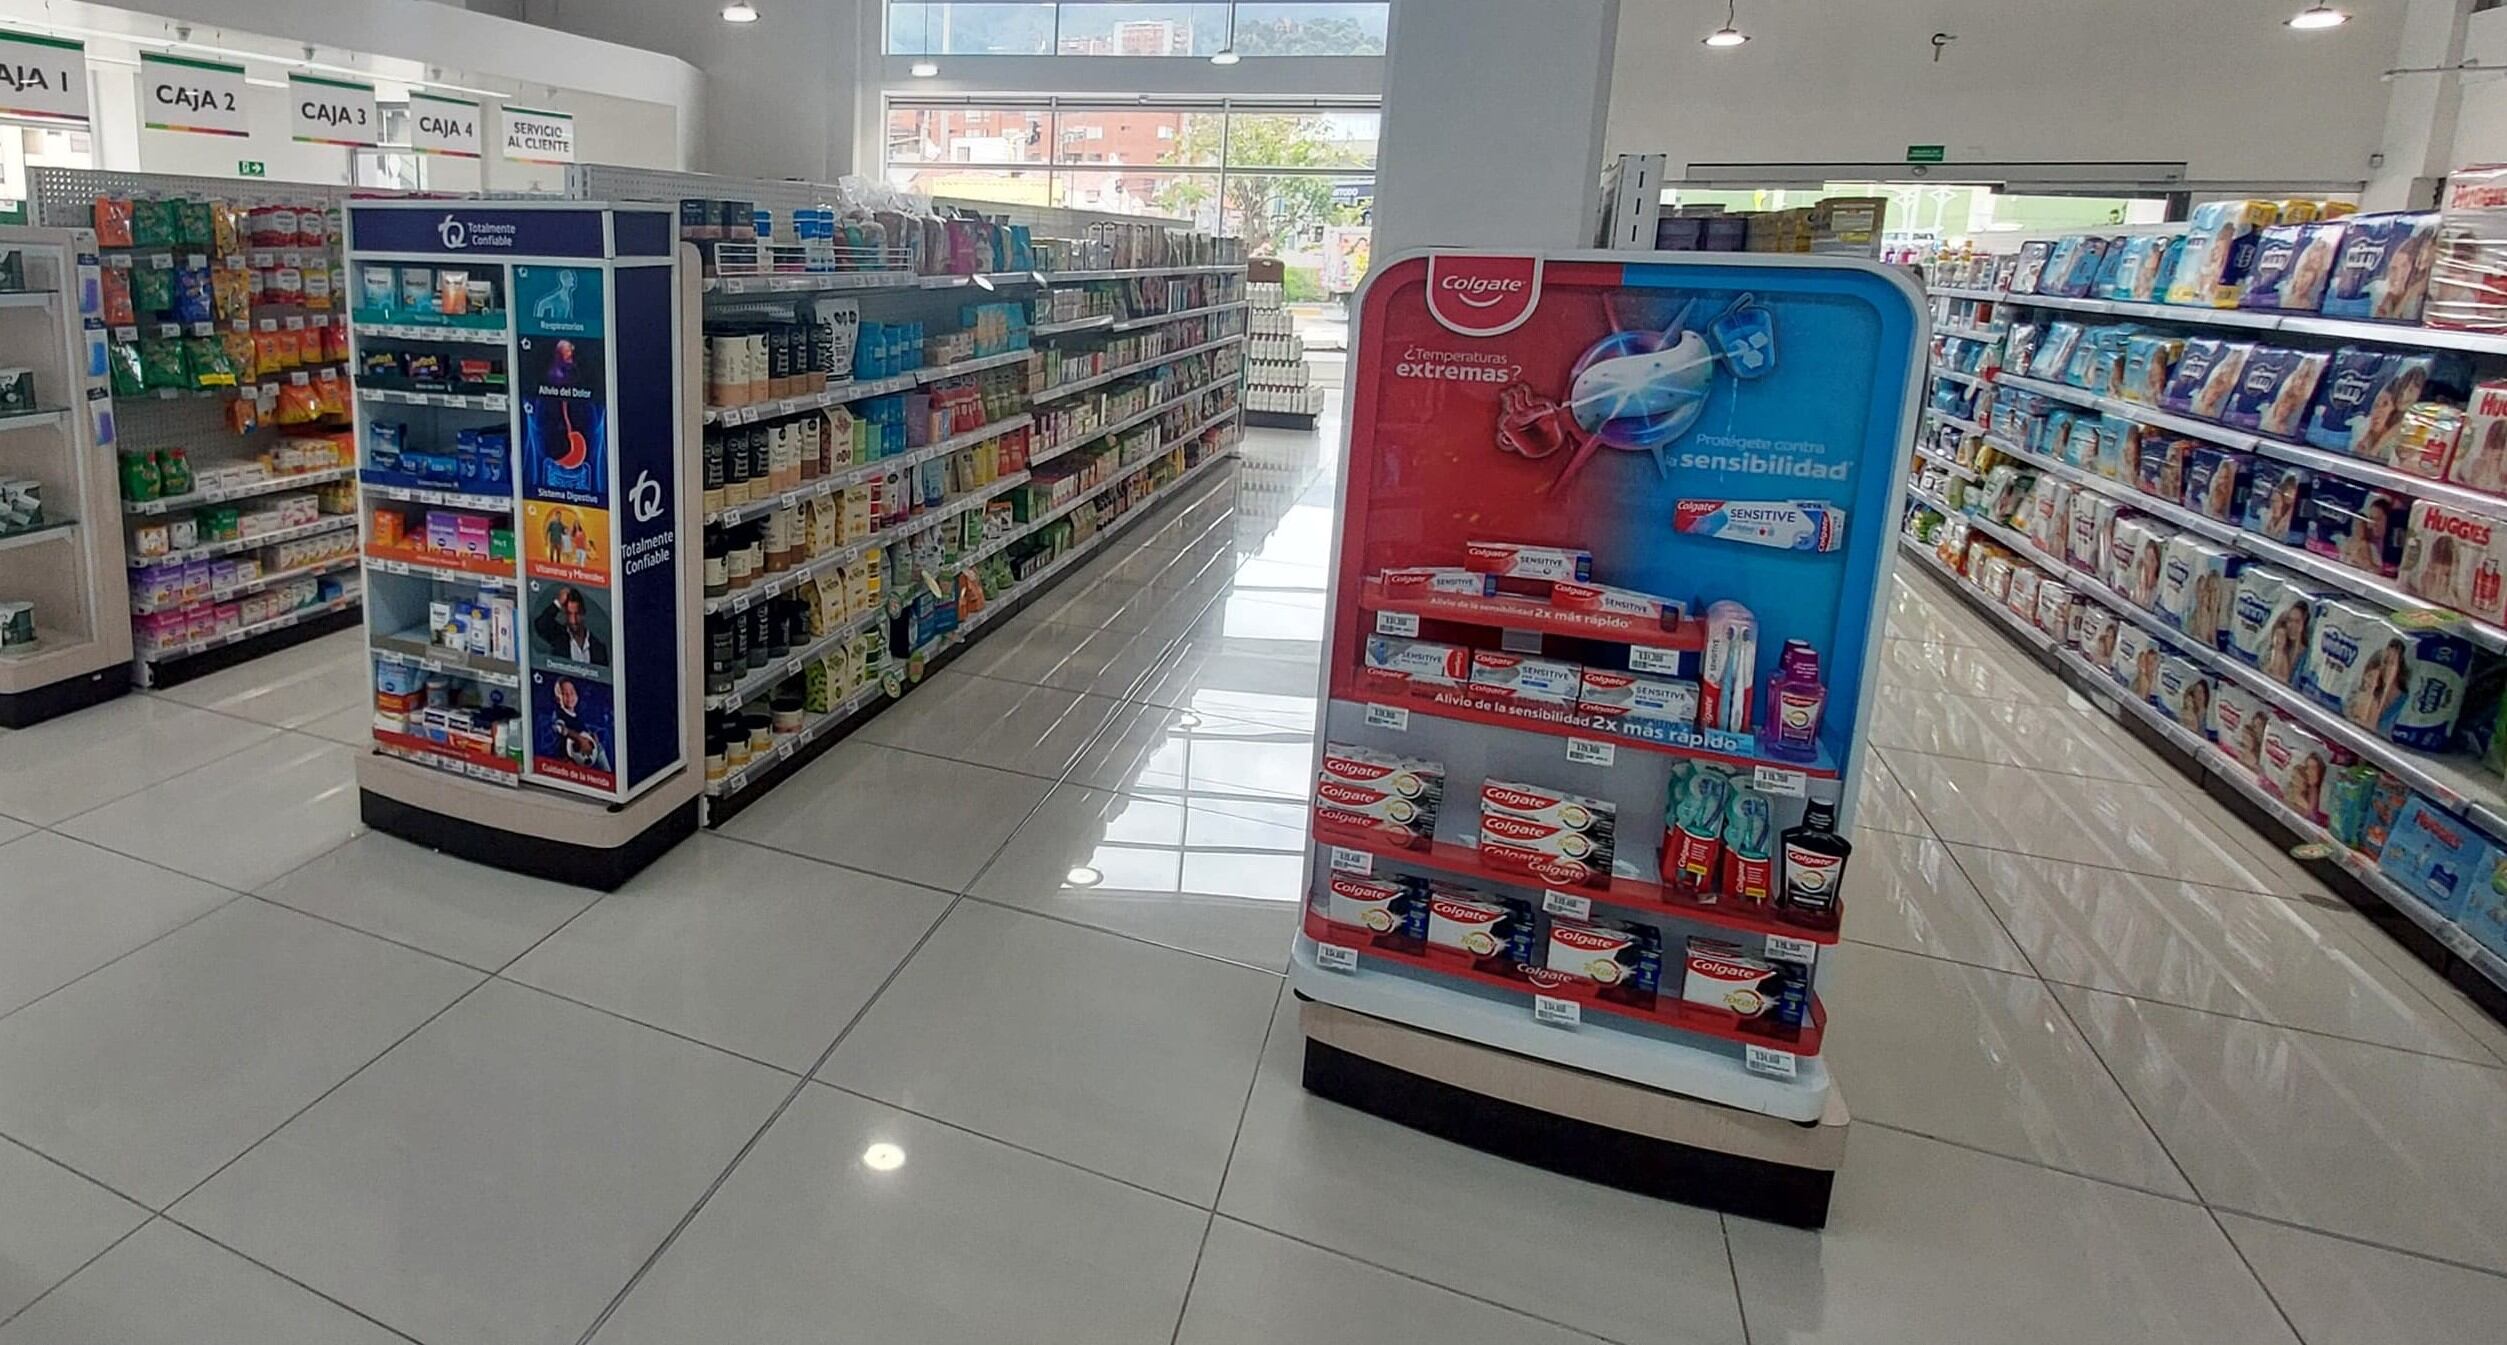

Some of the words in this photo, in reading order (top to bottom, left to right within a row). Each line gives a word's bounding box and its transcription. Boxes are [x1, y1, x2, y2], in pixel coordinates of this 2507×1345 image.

[156, 84, 218, 111] CAJA
[224, 92, 236, 111] 2
[302, 102, 353, 127] CAJA
[357, 108, 367, 125] 3
[419, 116, 461, 138] CAJA
[465, 122, 473, 138] 4
[513, 122, 563, 138] SERVICIO
[508, 137, 523, 149] AL
[525, 138, 569, 153] CLIENTE
[467, 222, 516, 235] Totalmente
[471, 235, 513, 247] Confiable
[1442, 275, 1522, 294] Colgate
[1404, 345, 1508, 364] ¿Temperaturas
[1396, 361, 1522, 383] extremas?
[560, 386, 571, 397] del
[572, 387, 592, 399] Dolor
[1696, 434, 1770, 451] Protégete
[1774, 439, 1826, 454] contra
[1666, 454, 1679, 468] la
[538, 487, 566, 499] Sistema
[1677, 500, 1716, 512] Colgate
[1730, 508, 1797, 523] SENSITIVE
[1818, 513, 1830, 553] Colgate
[2424, 506, 2492, 546] HUGGIES
[621, 531, 674, 561] Totalmente
[625, 549, 670, 576] Confiable
[1468, 547, 1509, 559] Colgate
[1520, 555, 1563, 567] SENSITIVE
[1391, 575, 1427, 584] Colgate
[1436, 578, 1474, 586] SENSITIVE
[1554, 583, 1595, 598] Colgate
[1604, 597, 1648, 613] SENSITIVE
[1430, 597, 1456, 607] Alivio
[1457, 600, 1469, 609] de
[1480, 603, 1534, 616] sensibilidad
[1534, 607, 1553, 619] 2x
[1554, 610, 1583, 624] más
[1400, 652, 1444, 664] SENSITIVE
[1710, 638, 1720, 672] SENSITIVE
[1367, 667, 1405, 677] Colgate
[1474, 653, 1515, 666] Colgate
[1522, 665, 1570, 681] SENSITIVE
[1469, 683, 1510, 695] Colgate
[1584, 673, 1628, 686] Colgate
[1635, 685, 1686, 701] SENSITIVE
[1579, 702, 1623, 714] Colgate
[1434, 691, 1472, 709] Alivio
[1474, 699, 1492, 712] de
[1494, 701, 1507, 714] la
[1508, 703, 1590, 727] sensibilidad
[1592, 715, 1618, 732] 2x
[1622, 721, 1665, 740] más
[1669, 727, 1738, 751] rápido
[570, 770, 579, 779] de
[580, 771, 586, 780] la
[1326, 759, 1381, 778] Colgate
[1320, 784, 1375, 803] Colgate
[1486, 787, 1547, 809] Colgate
[1318, 808, 1372, 827] Colgate
[1485, 817, 1546, 838] Colgate
[1678, 836, 1692, 868] Colgate
[1788, 850, 1834, 867] Colgate
[1527, 861, 1586, 880] Colgate
[1736, 860, 1746, 893] Colgate
[1334, 880, 1387, 900] Colgate
[1432, 901, 1490, 923] Colgate
[1554, 928, 1613, 950] Colgate
[1516, 963, 1573, 983] Colgate
[1692, 959, 1755, 980] Colgate
